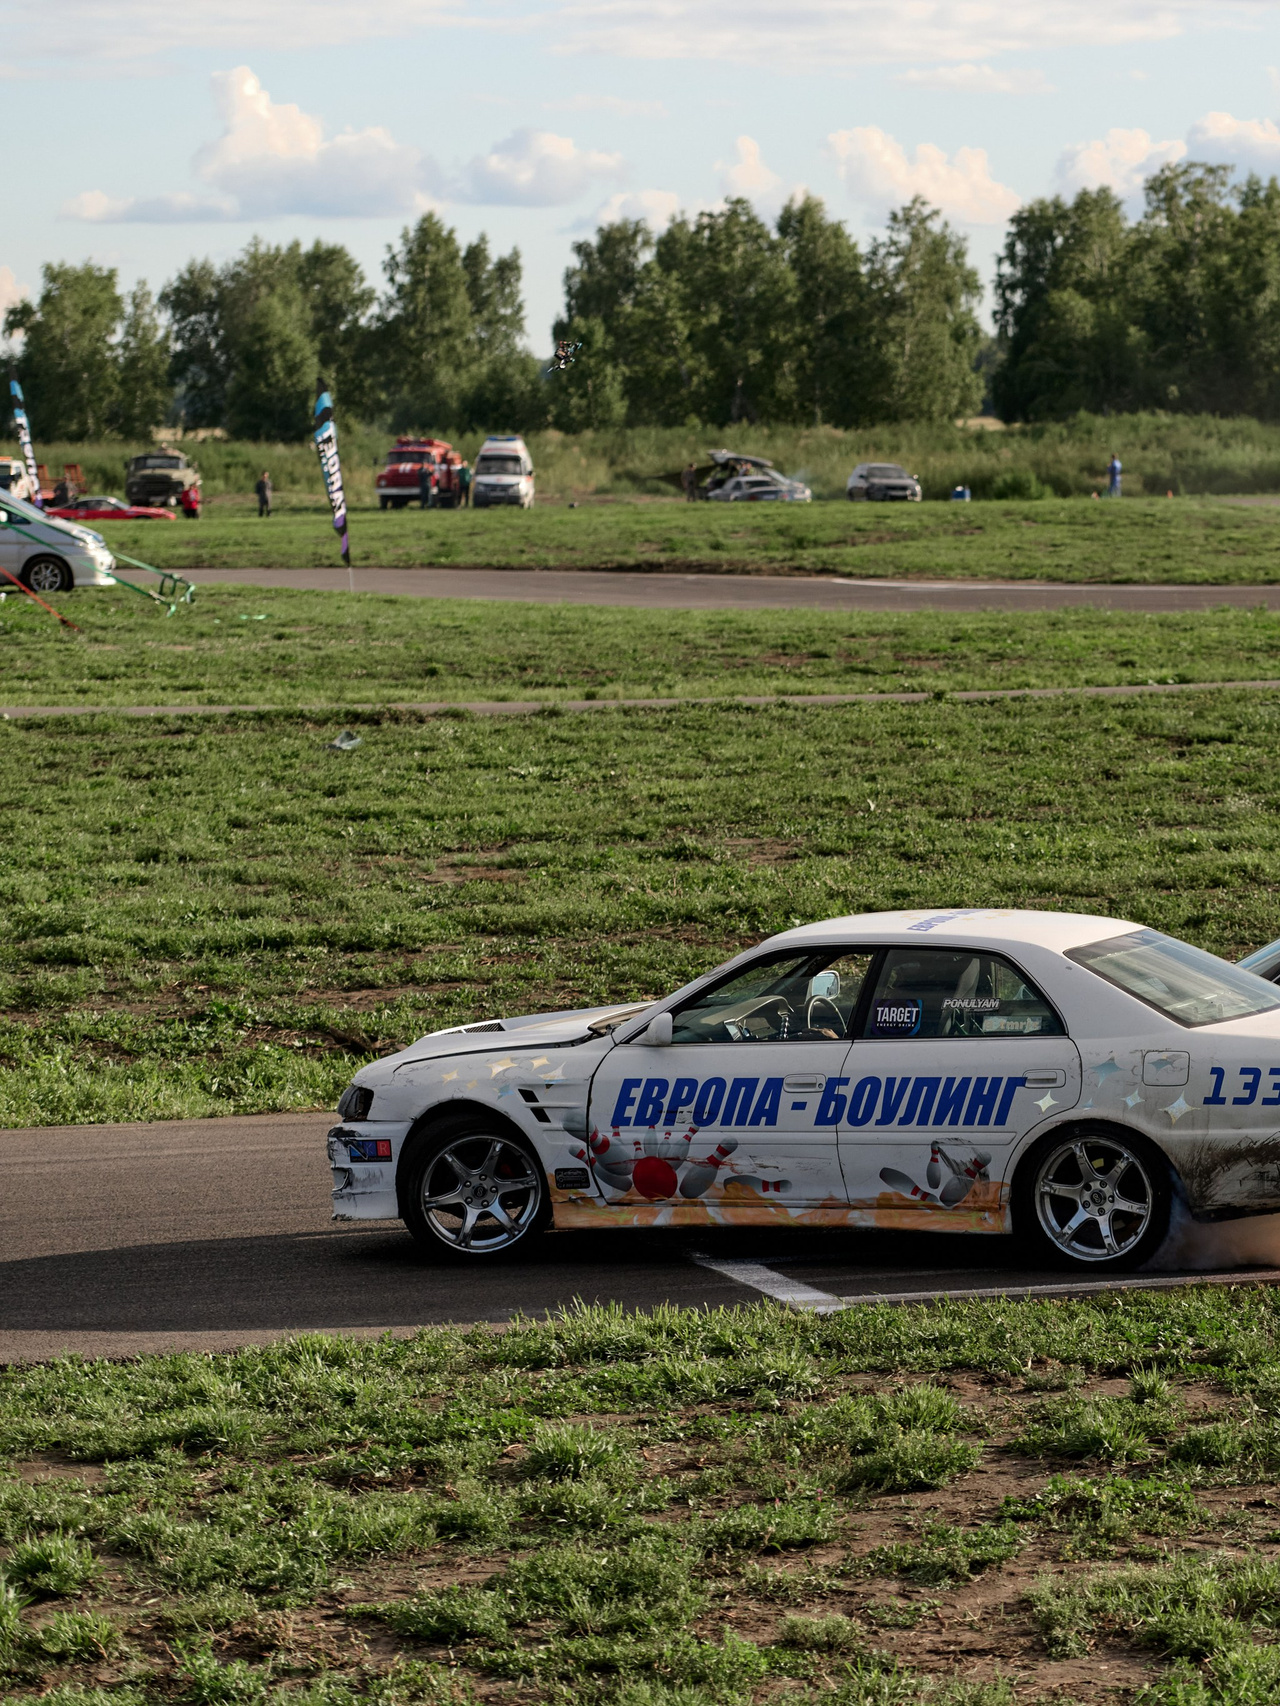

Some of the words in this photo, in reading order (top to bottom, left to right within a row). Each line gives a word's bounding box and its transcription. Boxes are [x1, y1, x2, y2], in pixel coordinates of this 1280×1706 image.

[942, 999, 1000, 1008] PONULYAM
[876, 1007, 920, 1022] TARGET
[611, 1077, 783, 1127] ЕВРОПА
[814, 1077, 1028, 1126] БОУЛИНГ
